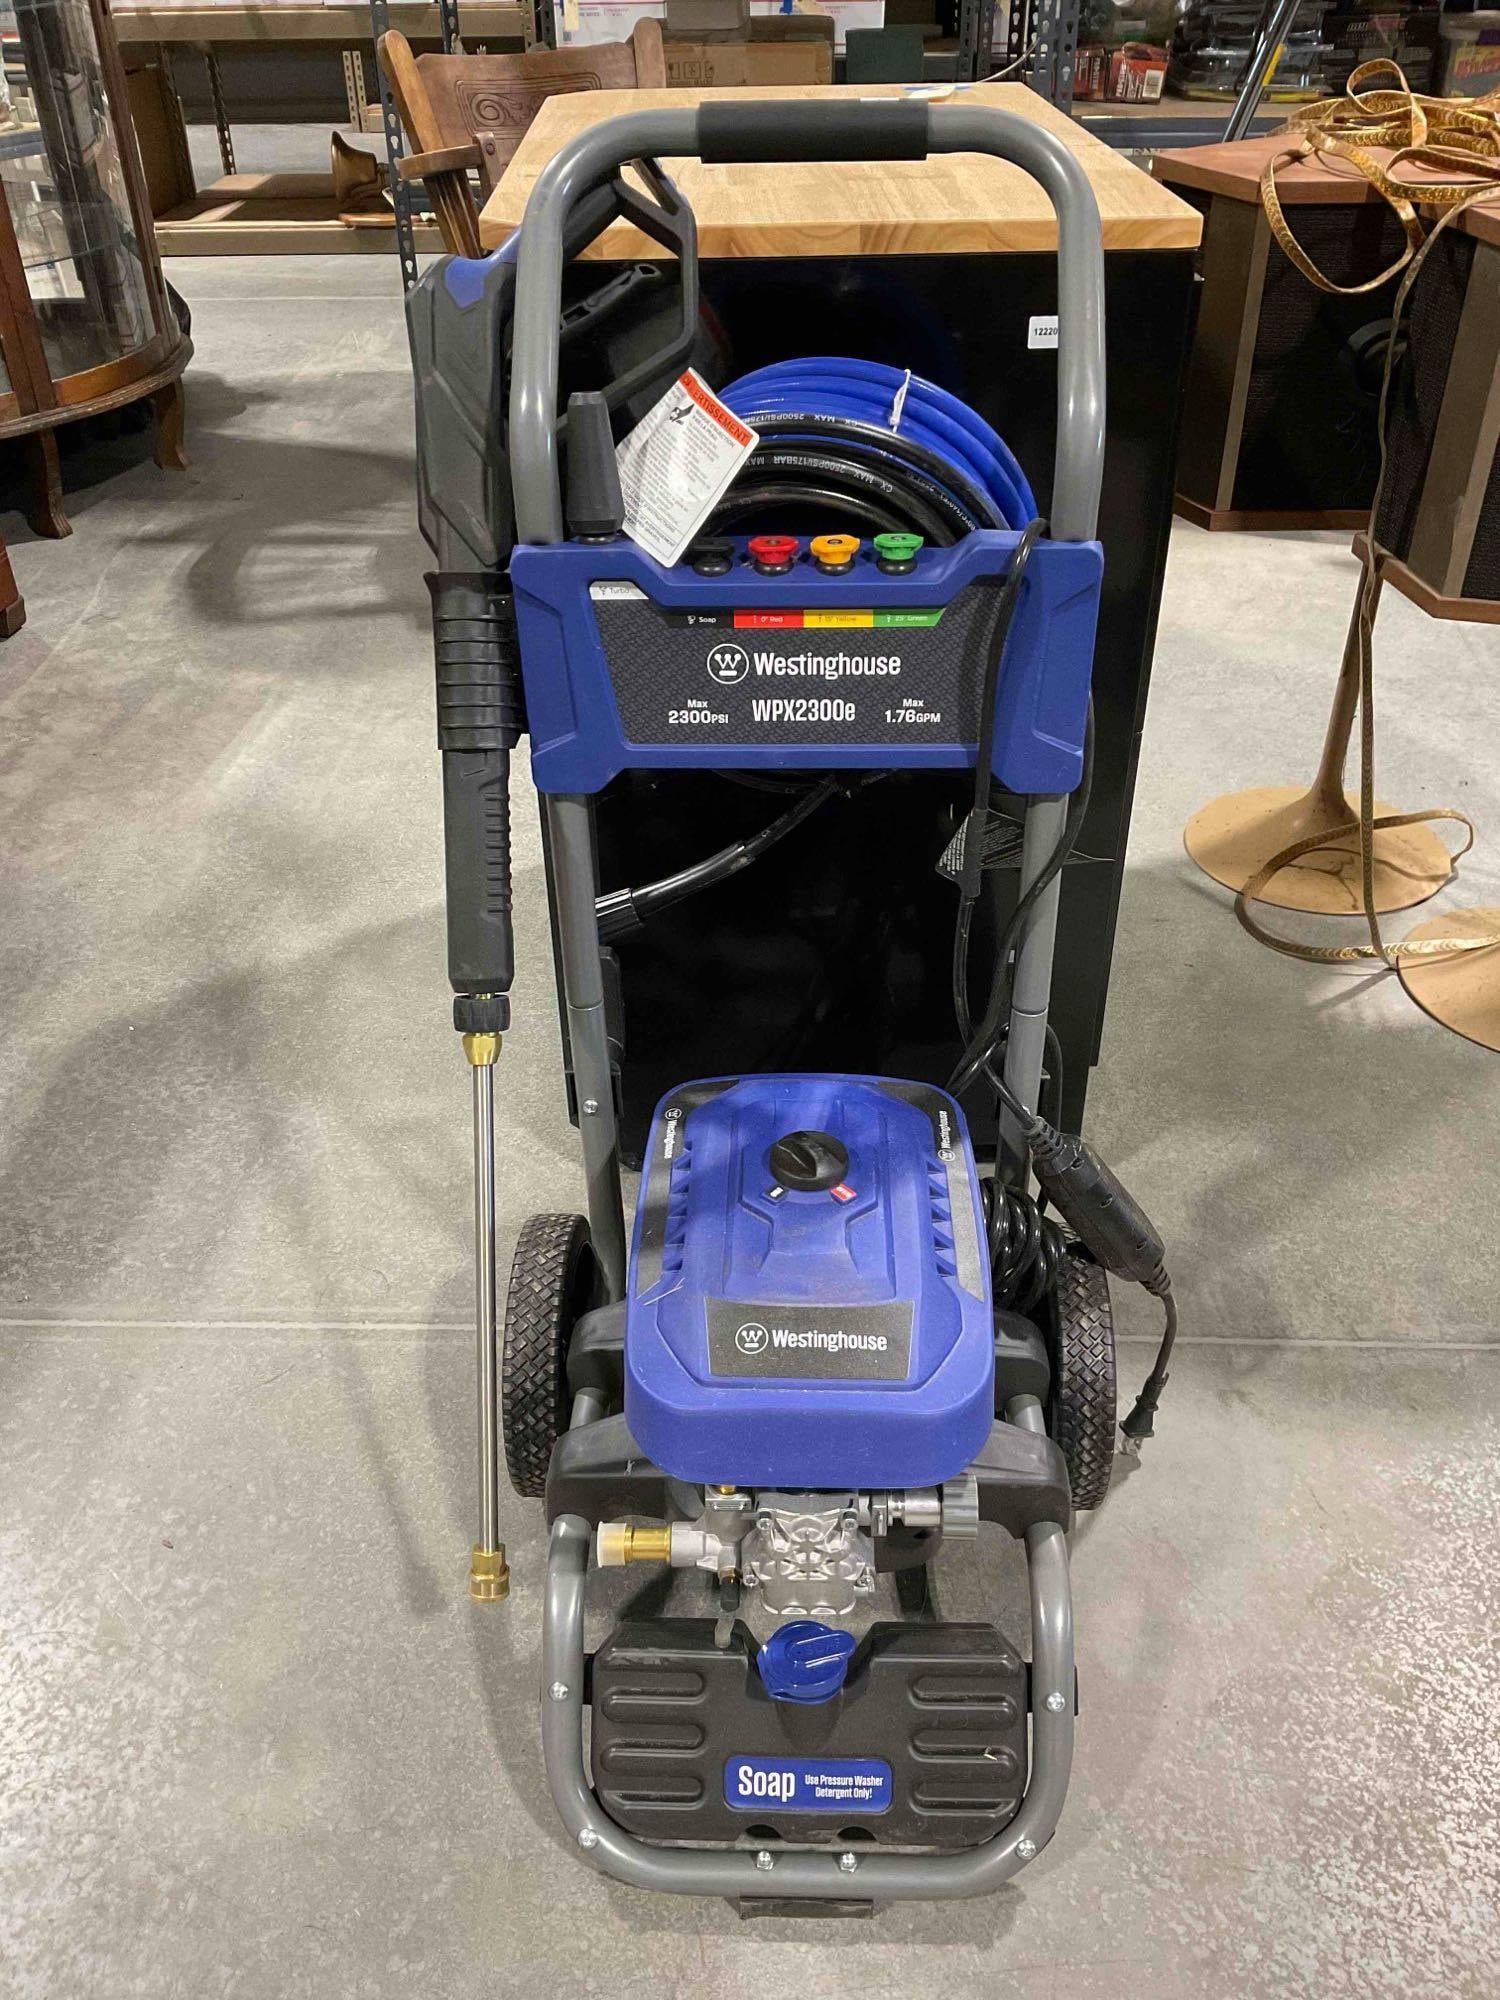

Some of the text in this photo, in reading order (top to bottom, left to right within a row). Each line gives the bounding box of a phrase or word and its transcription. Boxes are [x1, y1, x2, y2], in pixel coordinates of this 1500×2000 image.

[689, 386, 750, 444] ERTISSEMENT
[814, 414, 835, 423] MAX
[853, 470, 875, 484] MAX
[753, 652, 901, 681] Westinghouse
[687, 699, 708, 708] Max
[903, 698, 924, 708] Max
[668, 710, 729, 724] 2300PSI
[752, 699, 856, 722] WPX2300e
[884, 709, 941, 723] 1.76GPM
[939, 1110, 951, 1149] Westinghouse
[664, 1120, 677, 1159] Westinghouse
[772, 1329, 888, 1352] Westinghouse
[738, 1765, 796, 1803] Soap
[805, 1774, 883, 1787] Use Pressure Washer
[815, 1787, 873, 1801] Detergent Only!
